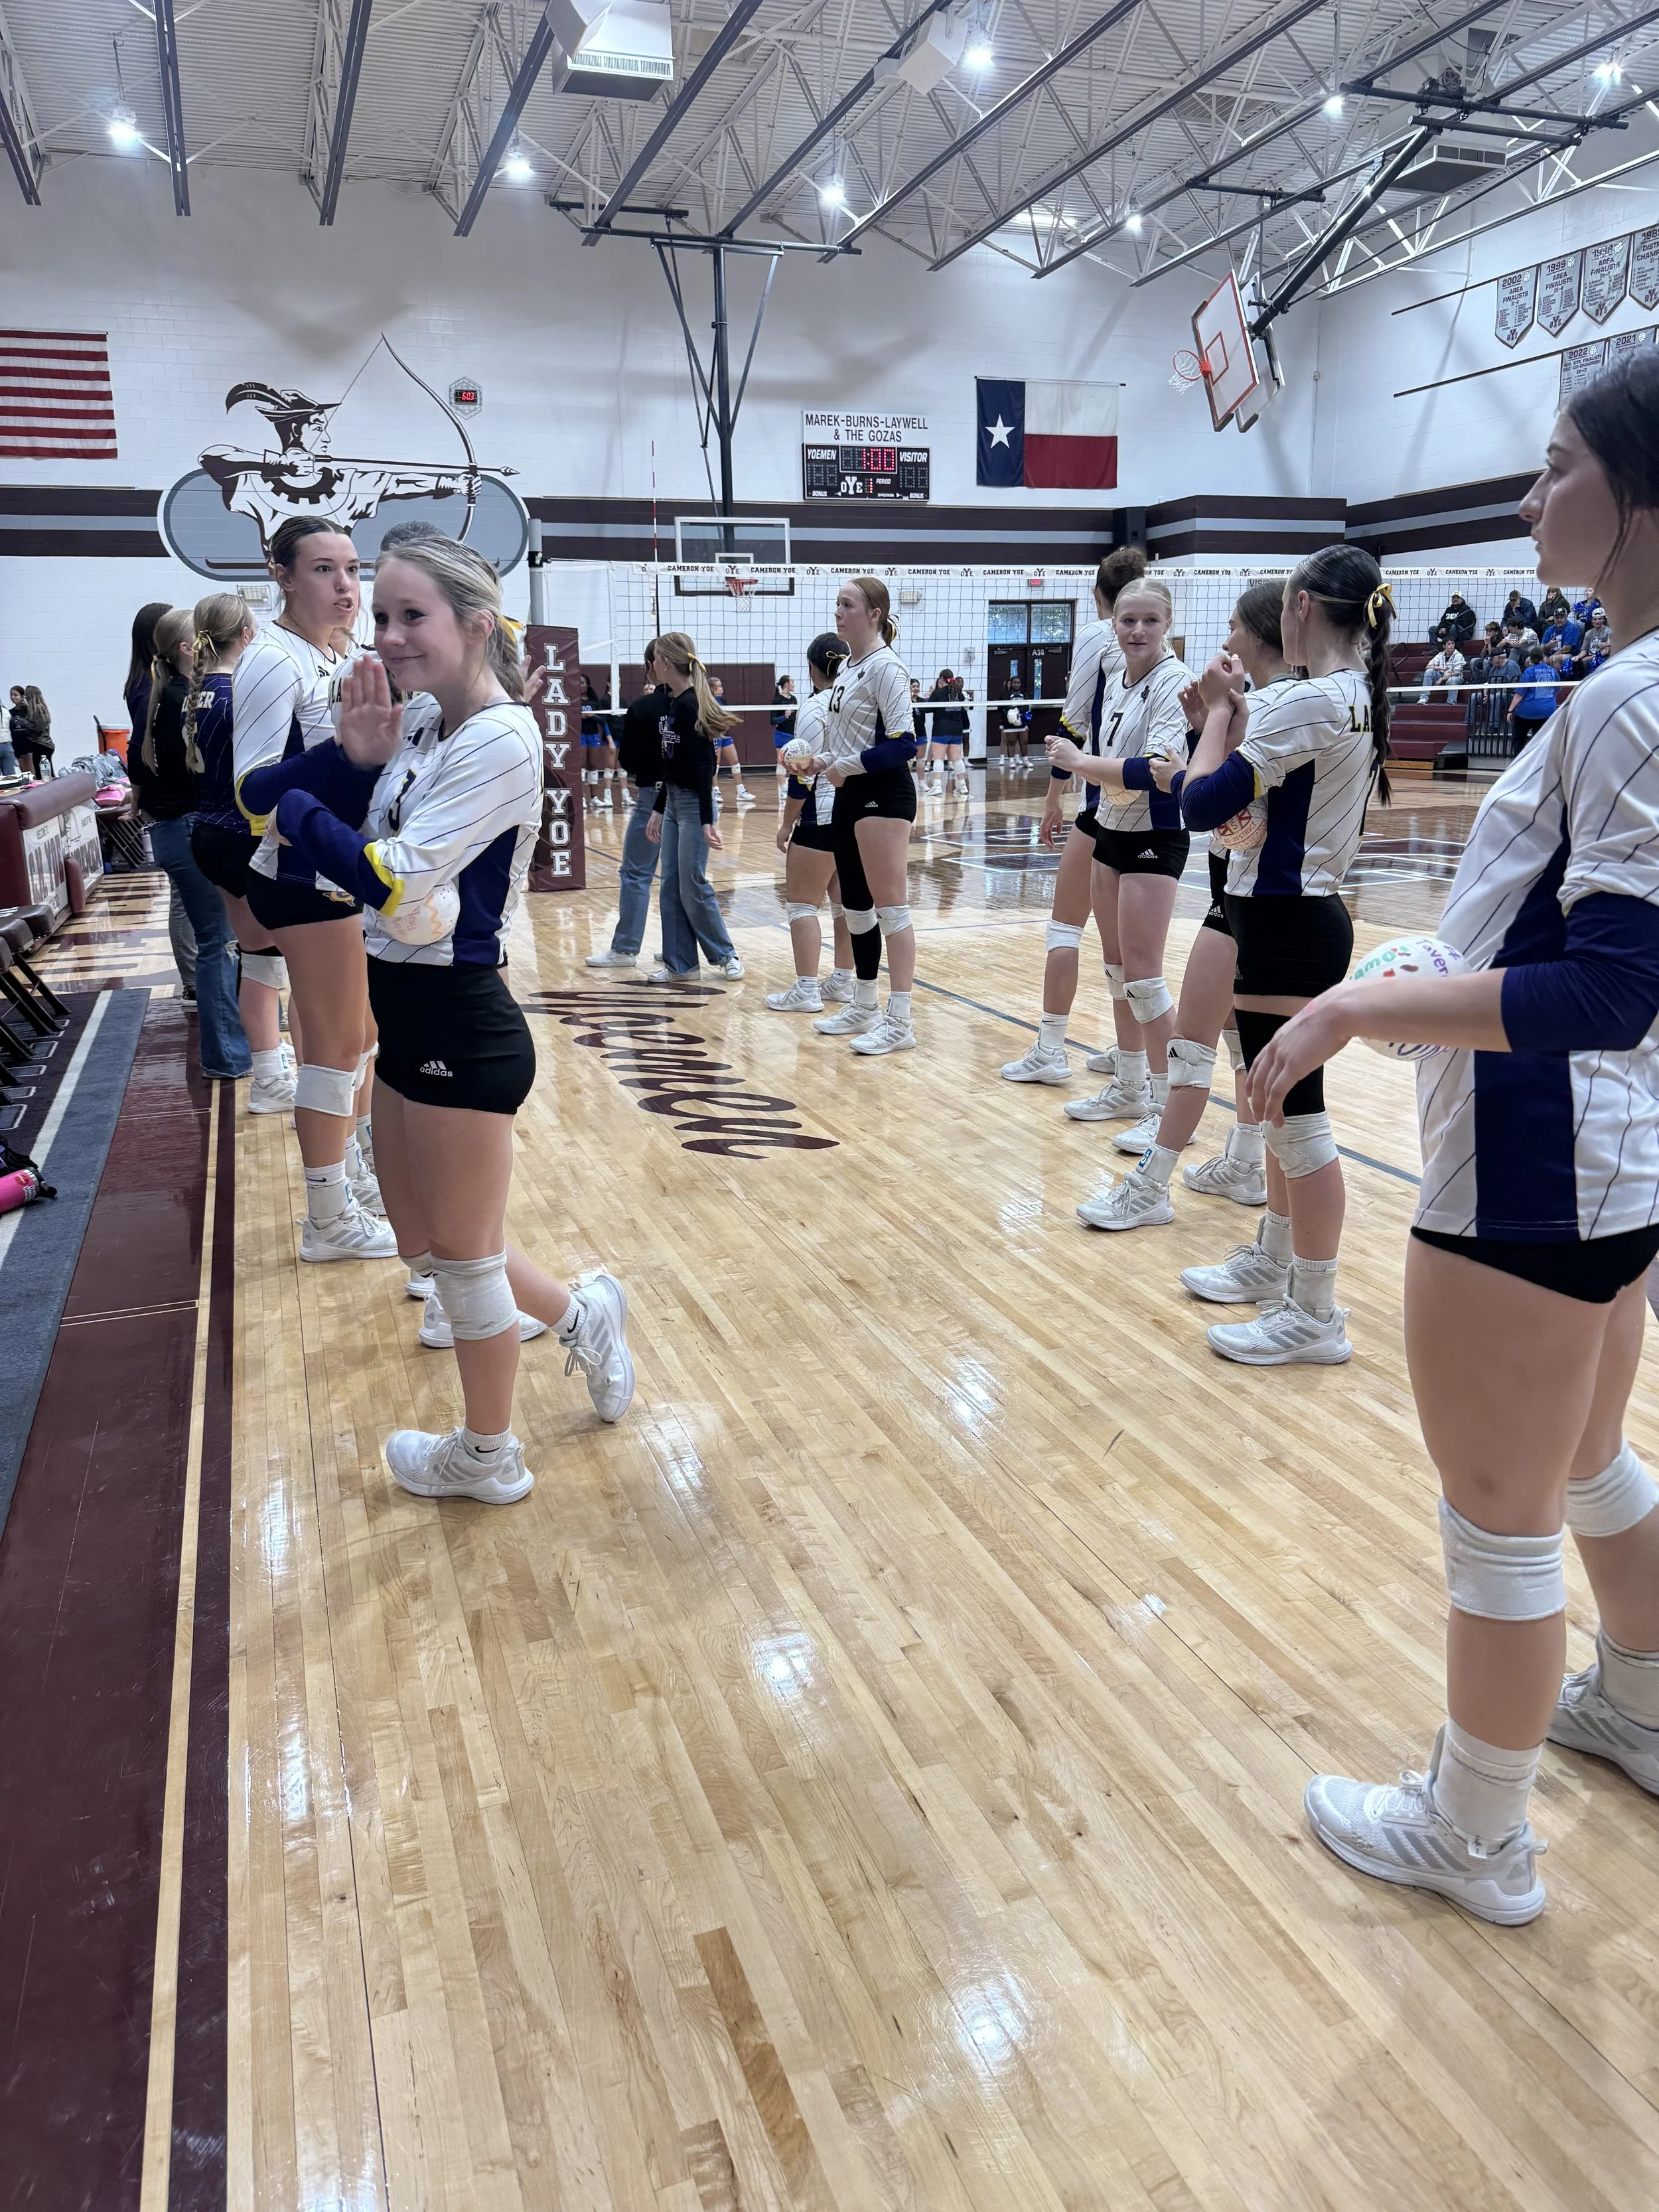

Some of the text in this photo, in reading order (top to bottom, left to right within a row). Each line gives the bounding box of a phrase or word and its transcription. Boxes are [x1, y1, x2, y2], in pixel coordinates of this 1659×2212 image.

[1547, 259, 1566, 273] 1999
[1599, 257, 1614, 266] AREA
[1502, 274, 1522, 287] 2002
[1553, 271, 1567, 281] AREA
[1546, 276, 1573, 290] FINALISTS
[1509, 285, 1523, 295] AREA
[1502, 291, 1528, 303] FINALISTS
[1616, 334, 1636, 346] 2021
[1568, 347, 1588, 359] 2022
[806, 413, 928, 429] MAREK-BURNS-LAYWELL
[833, 429, 902, 442] & THE GOZAS
[807, 448, 837, 460] YOEMEN
[899, 451, 928, 463] VISITOR
[829, 684, 845, 713] 13
[1107, 711, 1124, 747] 7
[542, 643, 572, 877] LADY YOE
[419, 1066, 453, 1077] adidas
